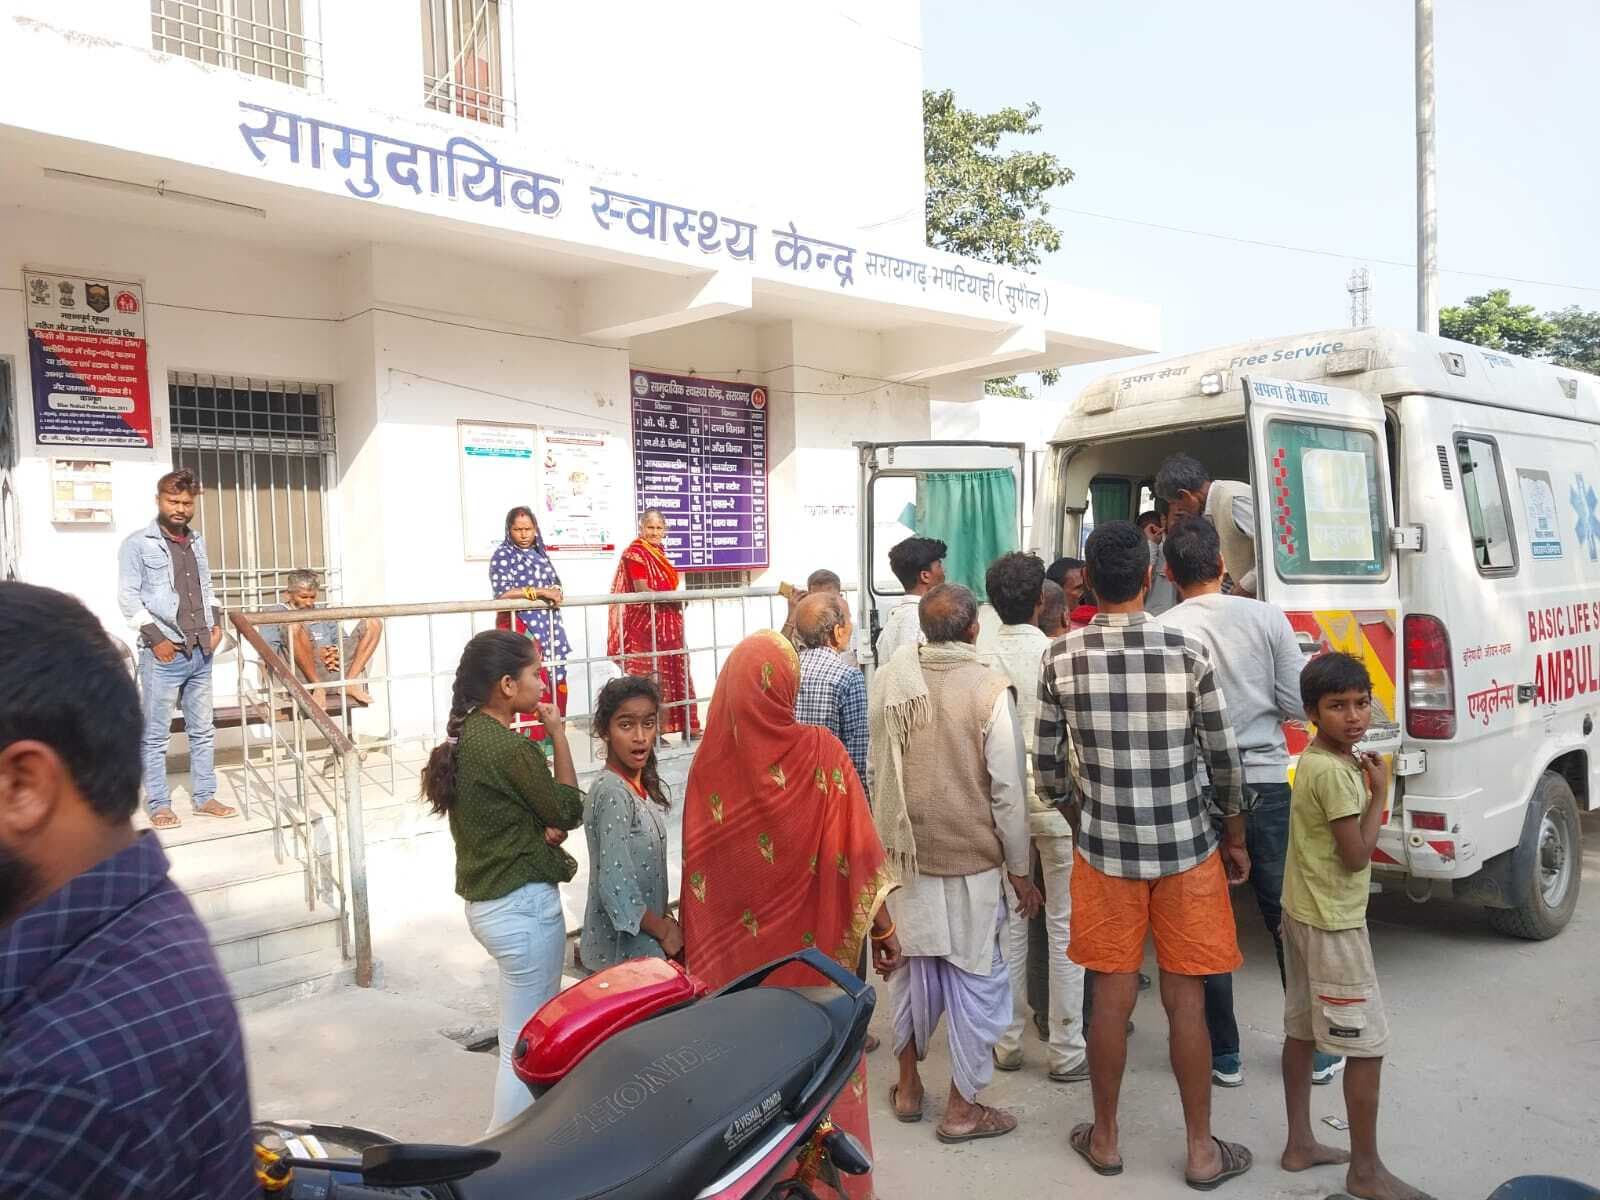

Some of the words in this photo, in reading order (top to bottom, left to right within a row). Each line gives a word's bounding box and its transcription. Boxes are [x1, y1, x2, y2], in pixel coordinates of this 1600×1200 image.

[238, 101, 563, 219] सामुदायिक
[590, 186, 757, 261] स्वास्थ्य
[772, 221, 856, 288] केन्द्र
[1230, 354, 1268, 369] Free
[1271, 341, 1344, 363] Service
[1527, 606, 1565, 643] BASIC
[1566, 602, 1591, 636] LIFE
[1592, 601, 1600, 630] S
[1533, 643, 1600, 708] AMBUL
